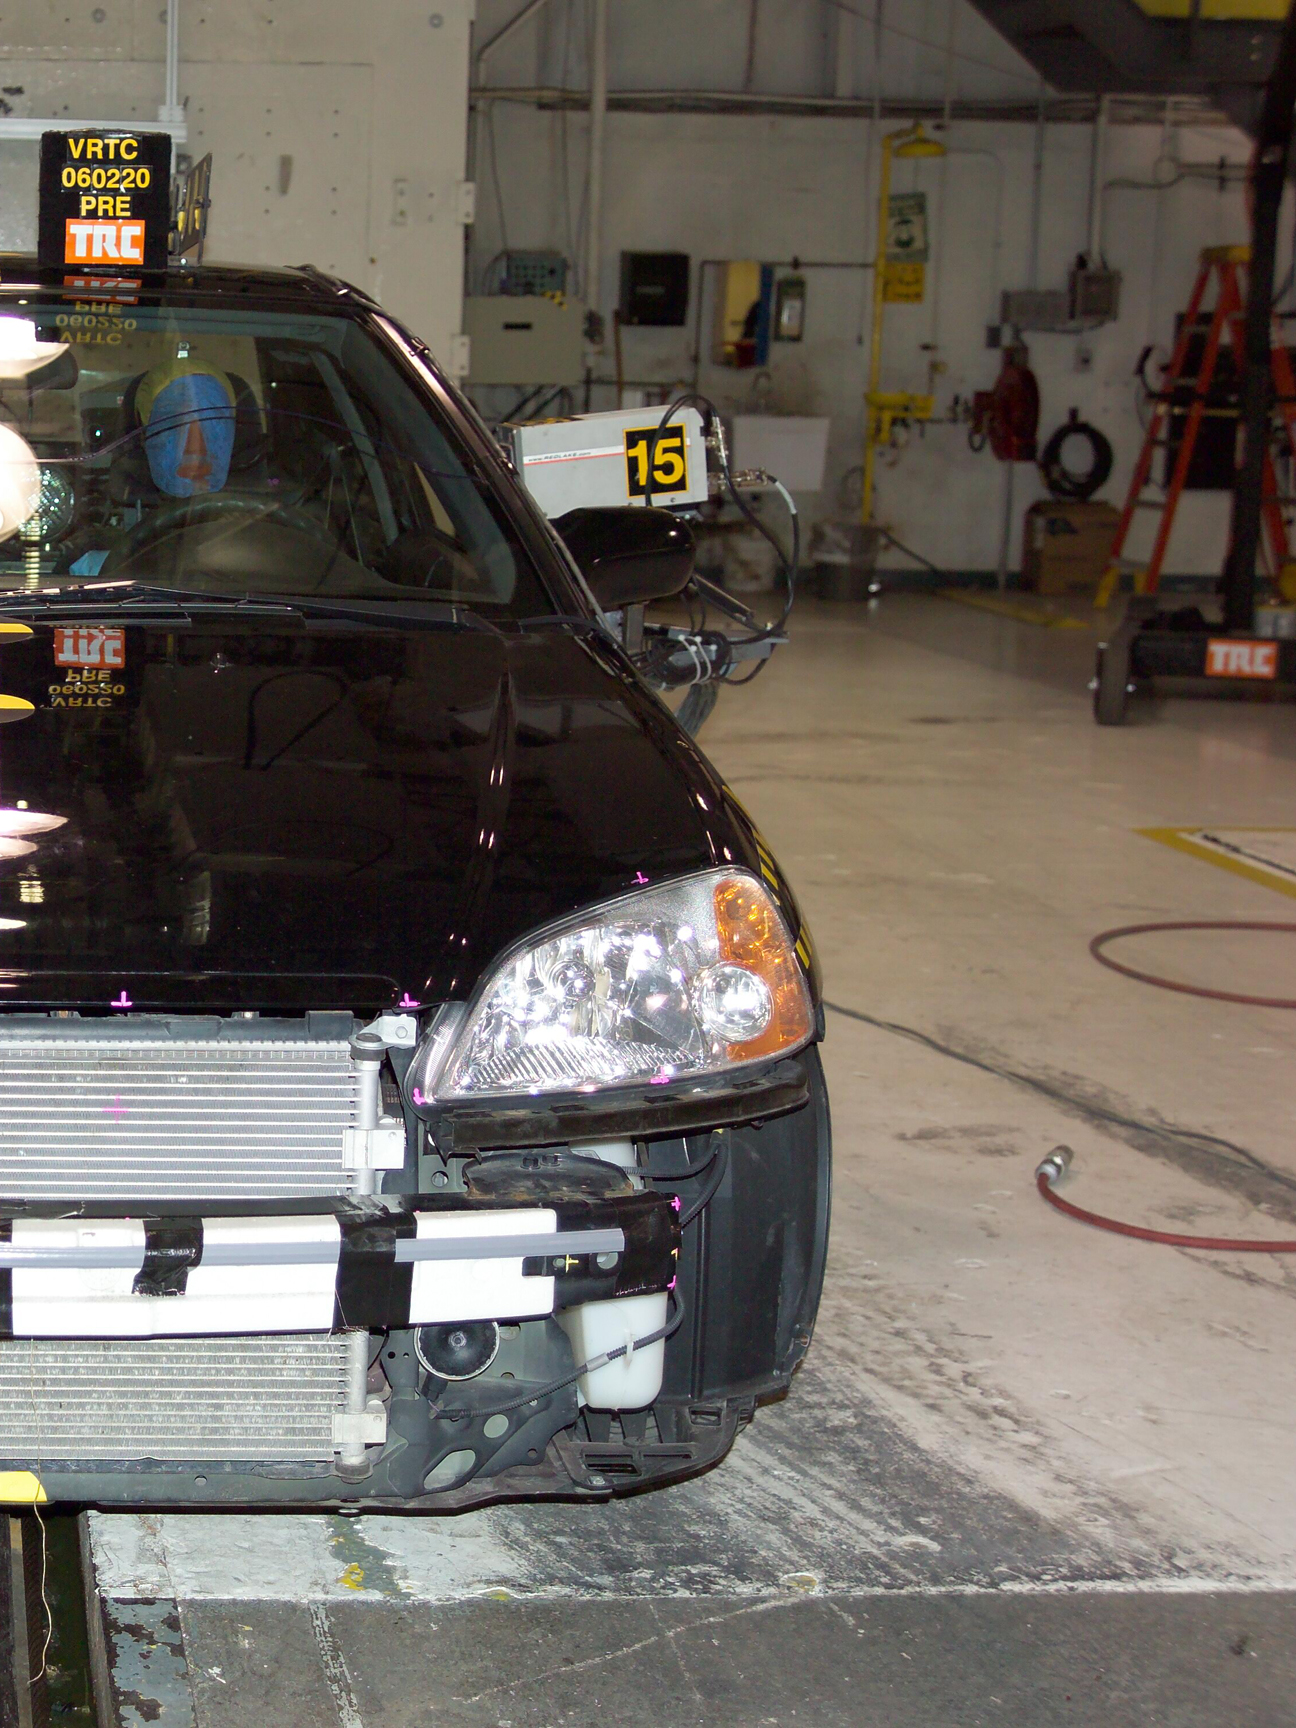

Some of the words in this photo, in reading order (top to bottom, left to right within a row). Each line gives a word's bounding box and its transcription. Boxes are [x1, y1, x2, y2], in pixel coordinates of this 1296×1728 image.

[68, 138, 138, 160] VRTC
[62, 167, 150, 188] 060220
[81, 196, 131, 217] PRE
[69, 224, 141, 259] TRC
[628, 437, 684, 486] 15
[1209, 643, 1273, 675] TRC
